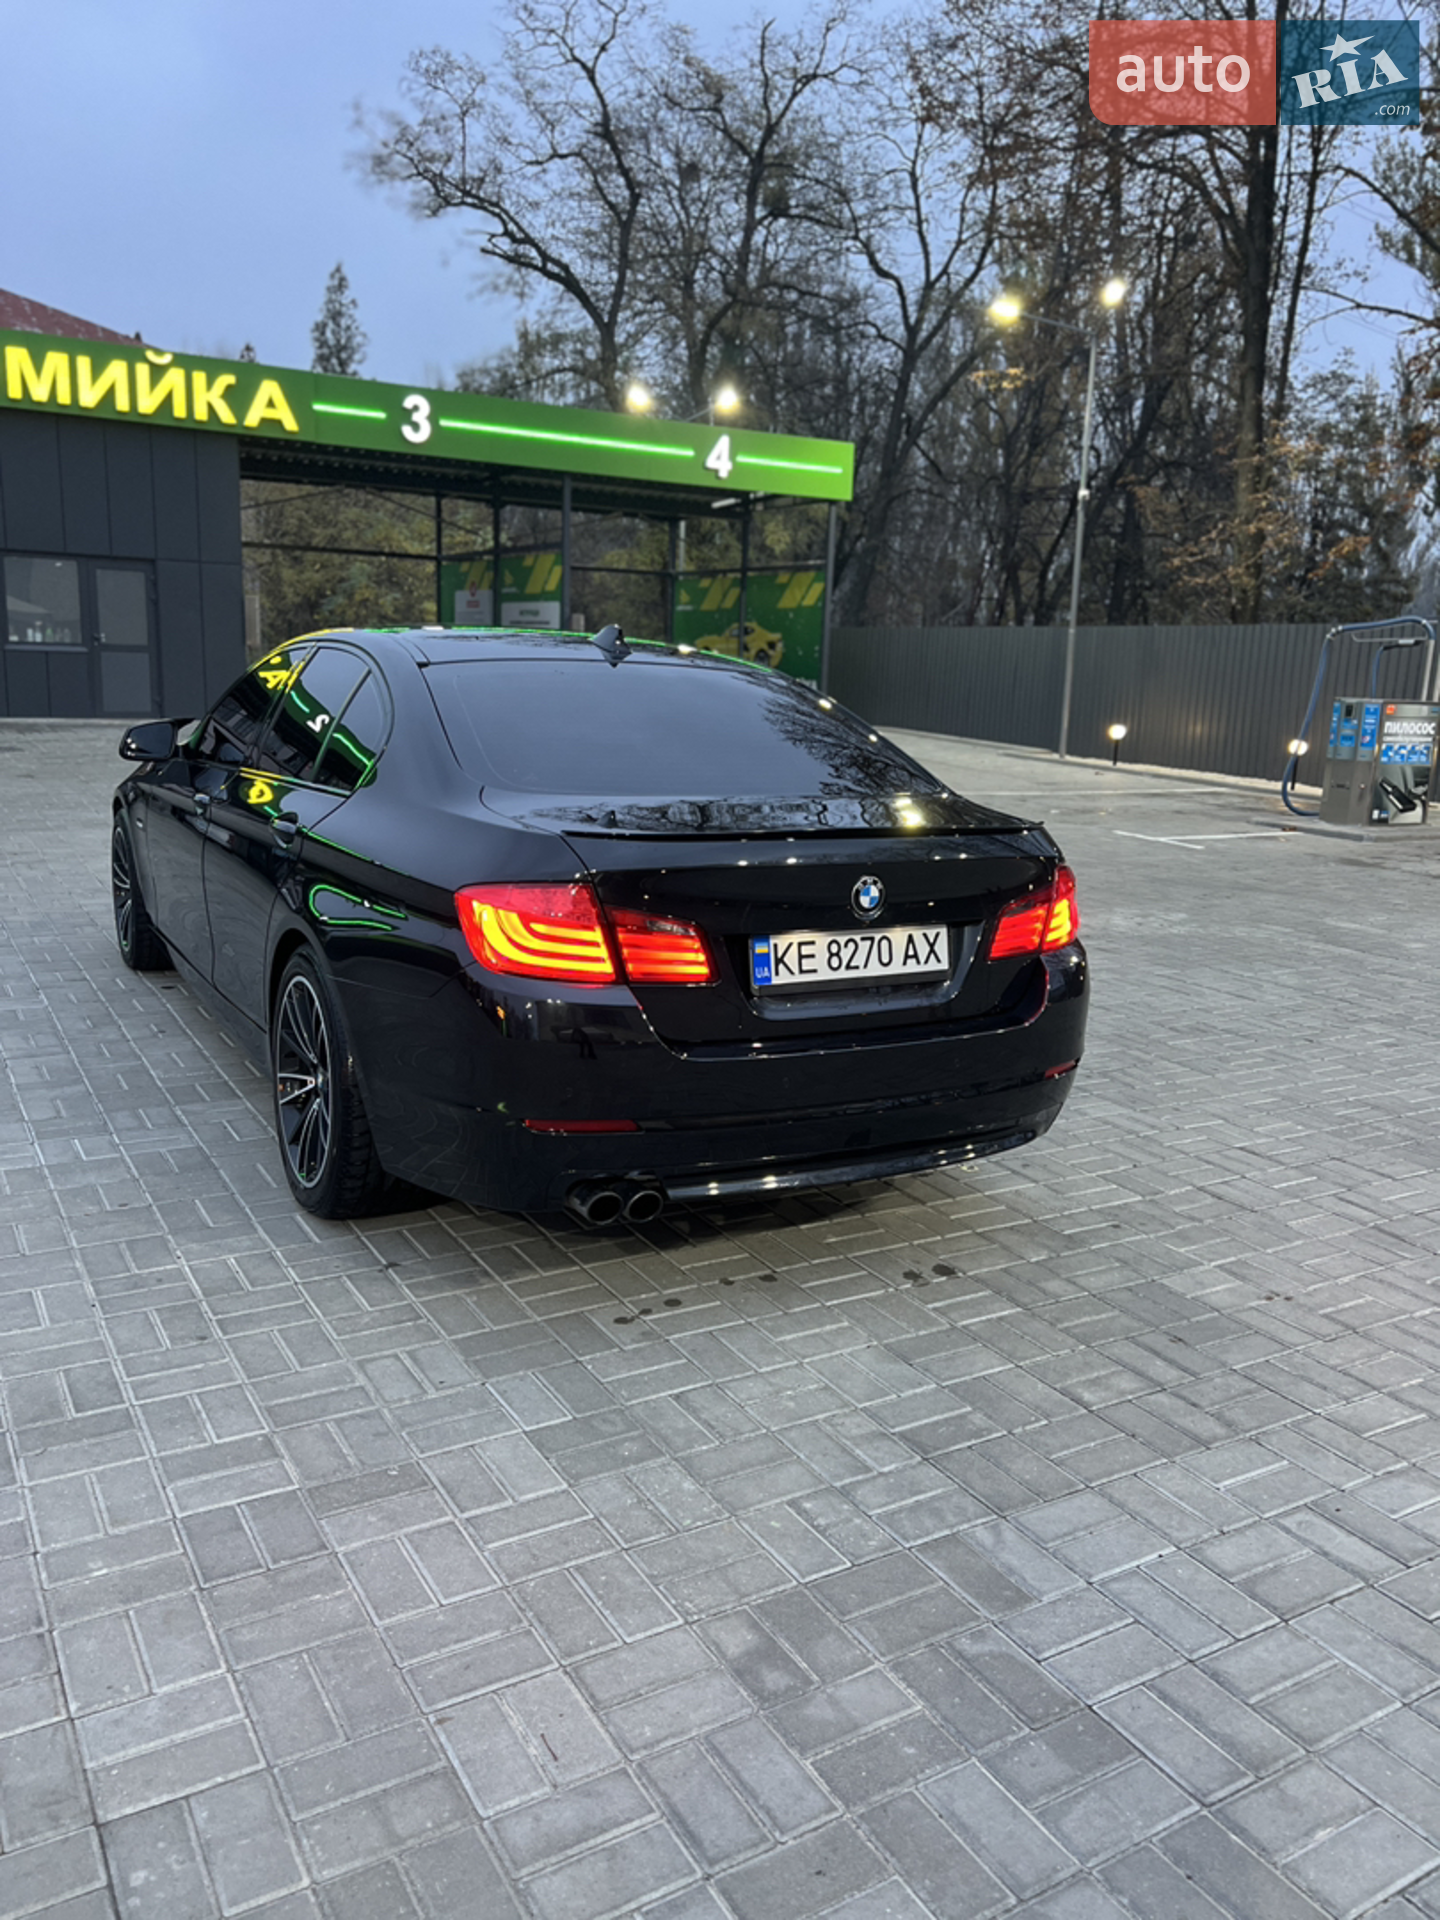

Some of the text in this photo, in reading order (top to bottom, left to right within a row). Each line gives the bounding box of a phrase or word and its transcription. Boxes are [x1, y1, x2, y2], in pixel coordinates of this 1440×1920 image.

[5, 345, 299, 432] МИЙКА
[401, 394, 431, 443] 3
[704, 434, 733, 479] 4
[755, 966, 770, 979] UA
[773, 931, 941, 976] KE 8270 AX
